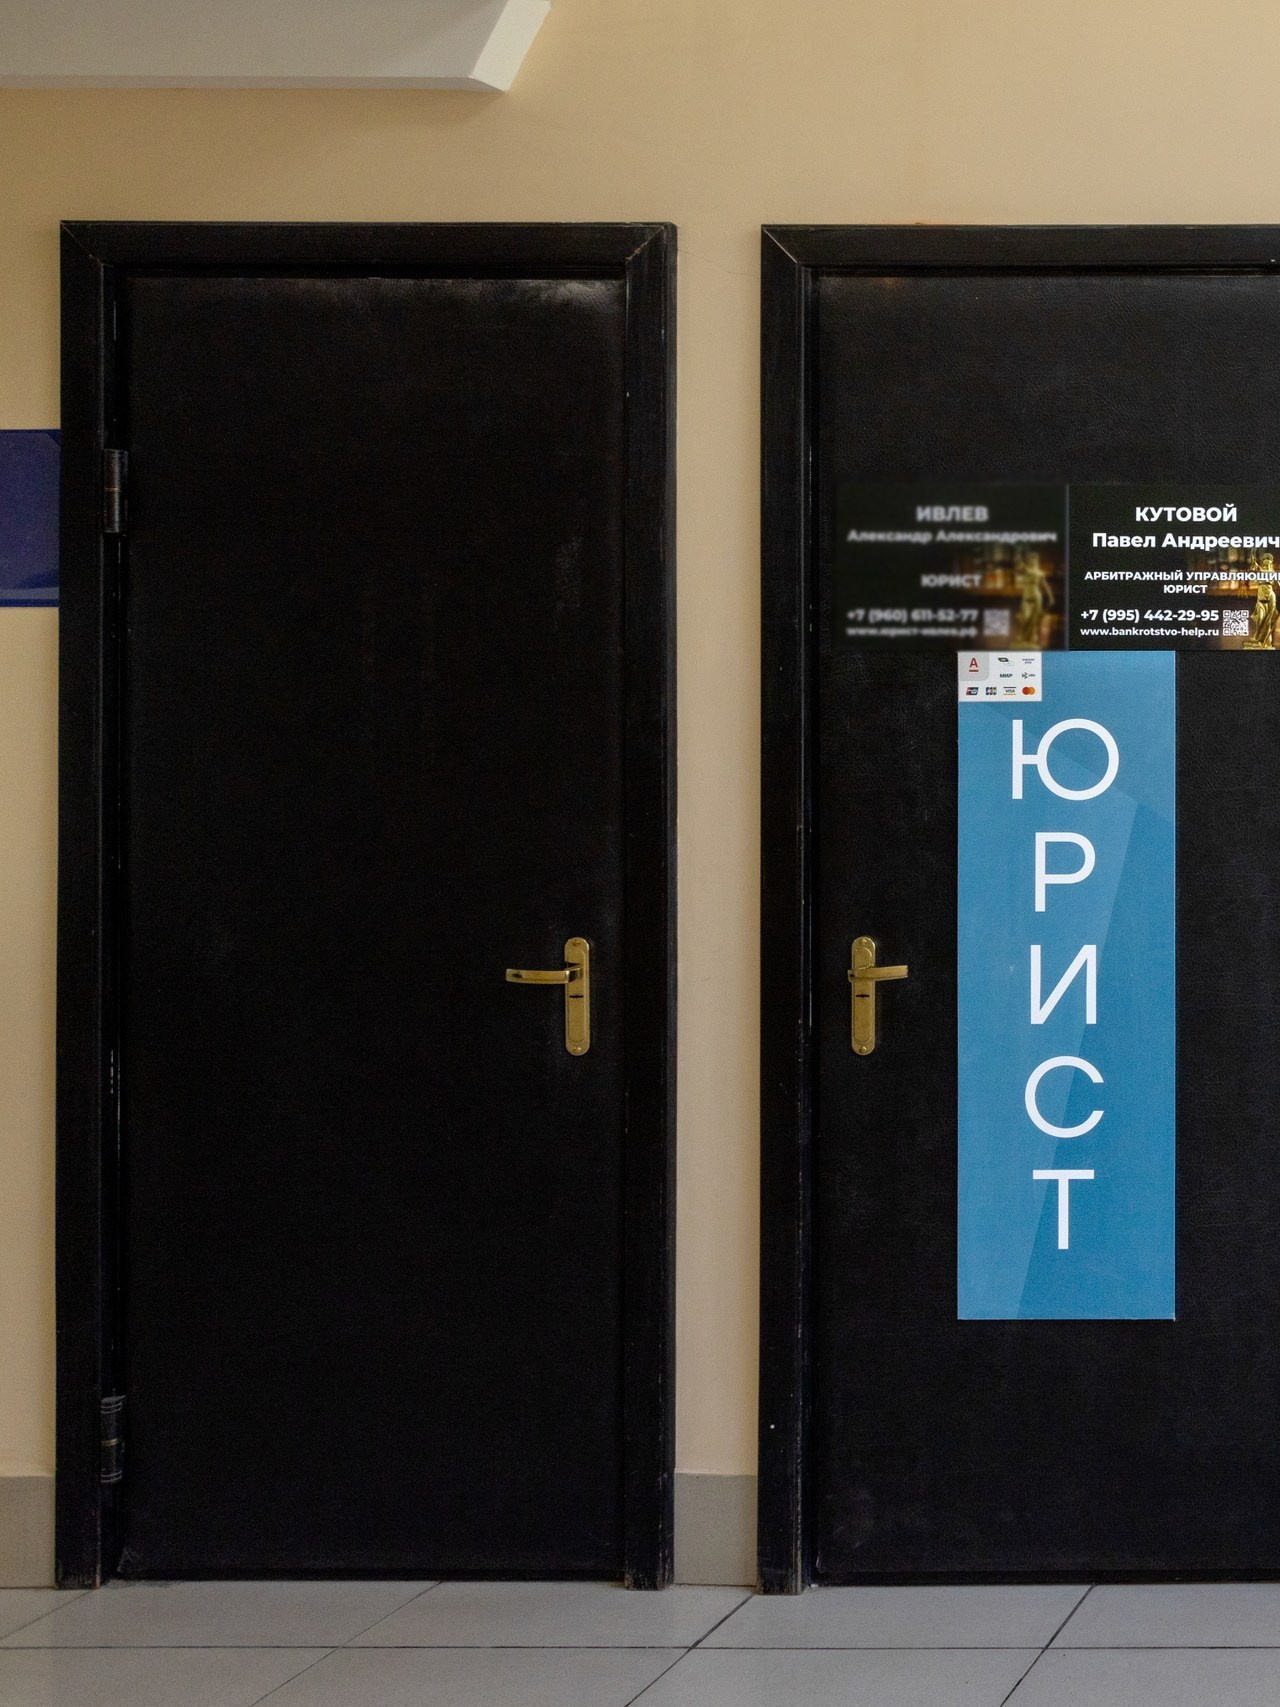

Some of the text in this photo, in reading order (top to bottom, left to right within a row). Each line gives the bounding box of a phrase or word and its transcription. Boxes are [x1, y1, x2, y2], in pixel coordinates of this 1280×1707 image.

[916, 505, 989, 522] ИВЛЕВ
[1135, 503, 1237, 522] КУТОВОЙ
[847, 529, 1058, 543] Александр Александрович
[1092, 533, 1280, 551] Павел Андреевич
[921, 573, 982, 587] ЮРИСТ
[1084, 569, 1183, 581] АРБИТРАЖНЫЙ
[1163, 584, 1207, 594] ЮРИСТ
[846, 608, 979, 624] +7 (960) 611-52-77
[1081, 609, 1219, 623] +7 (995) 442-29-95
[1080, 627, 1219, 638] www.bankrotstvo-help.ru
[1011, 718, 1120, 1250] ЮРИСТ
